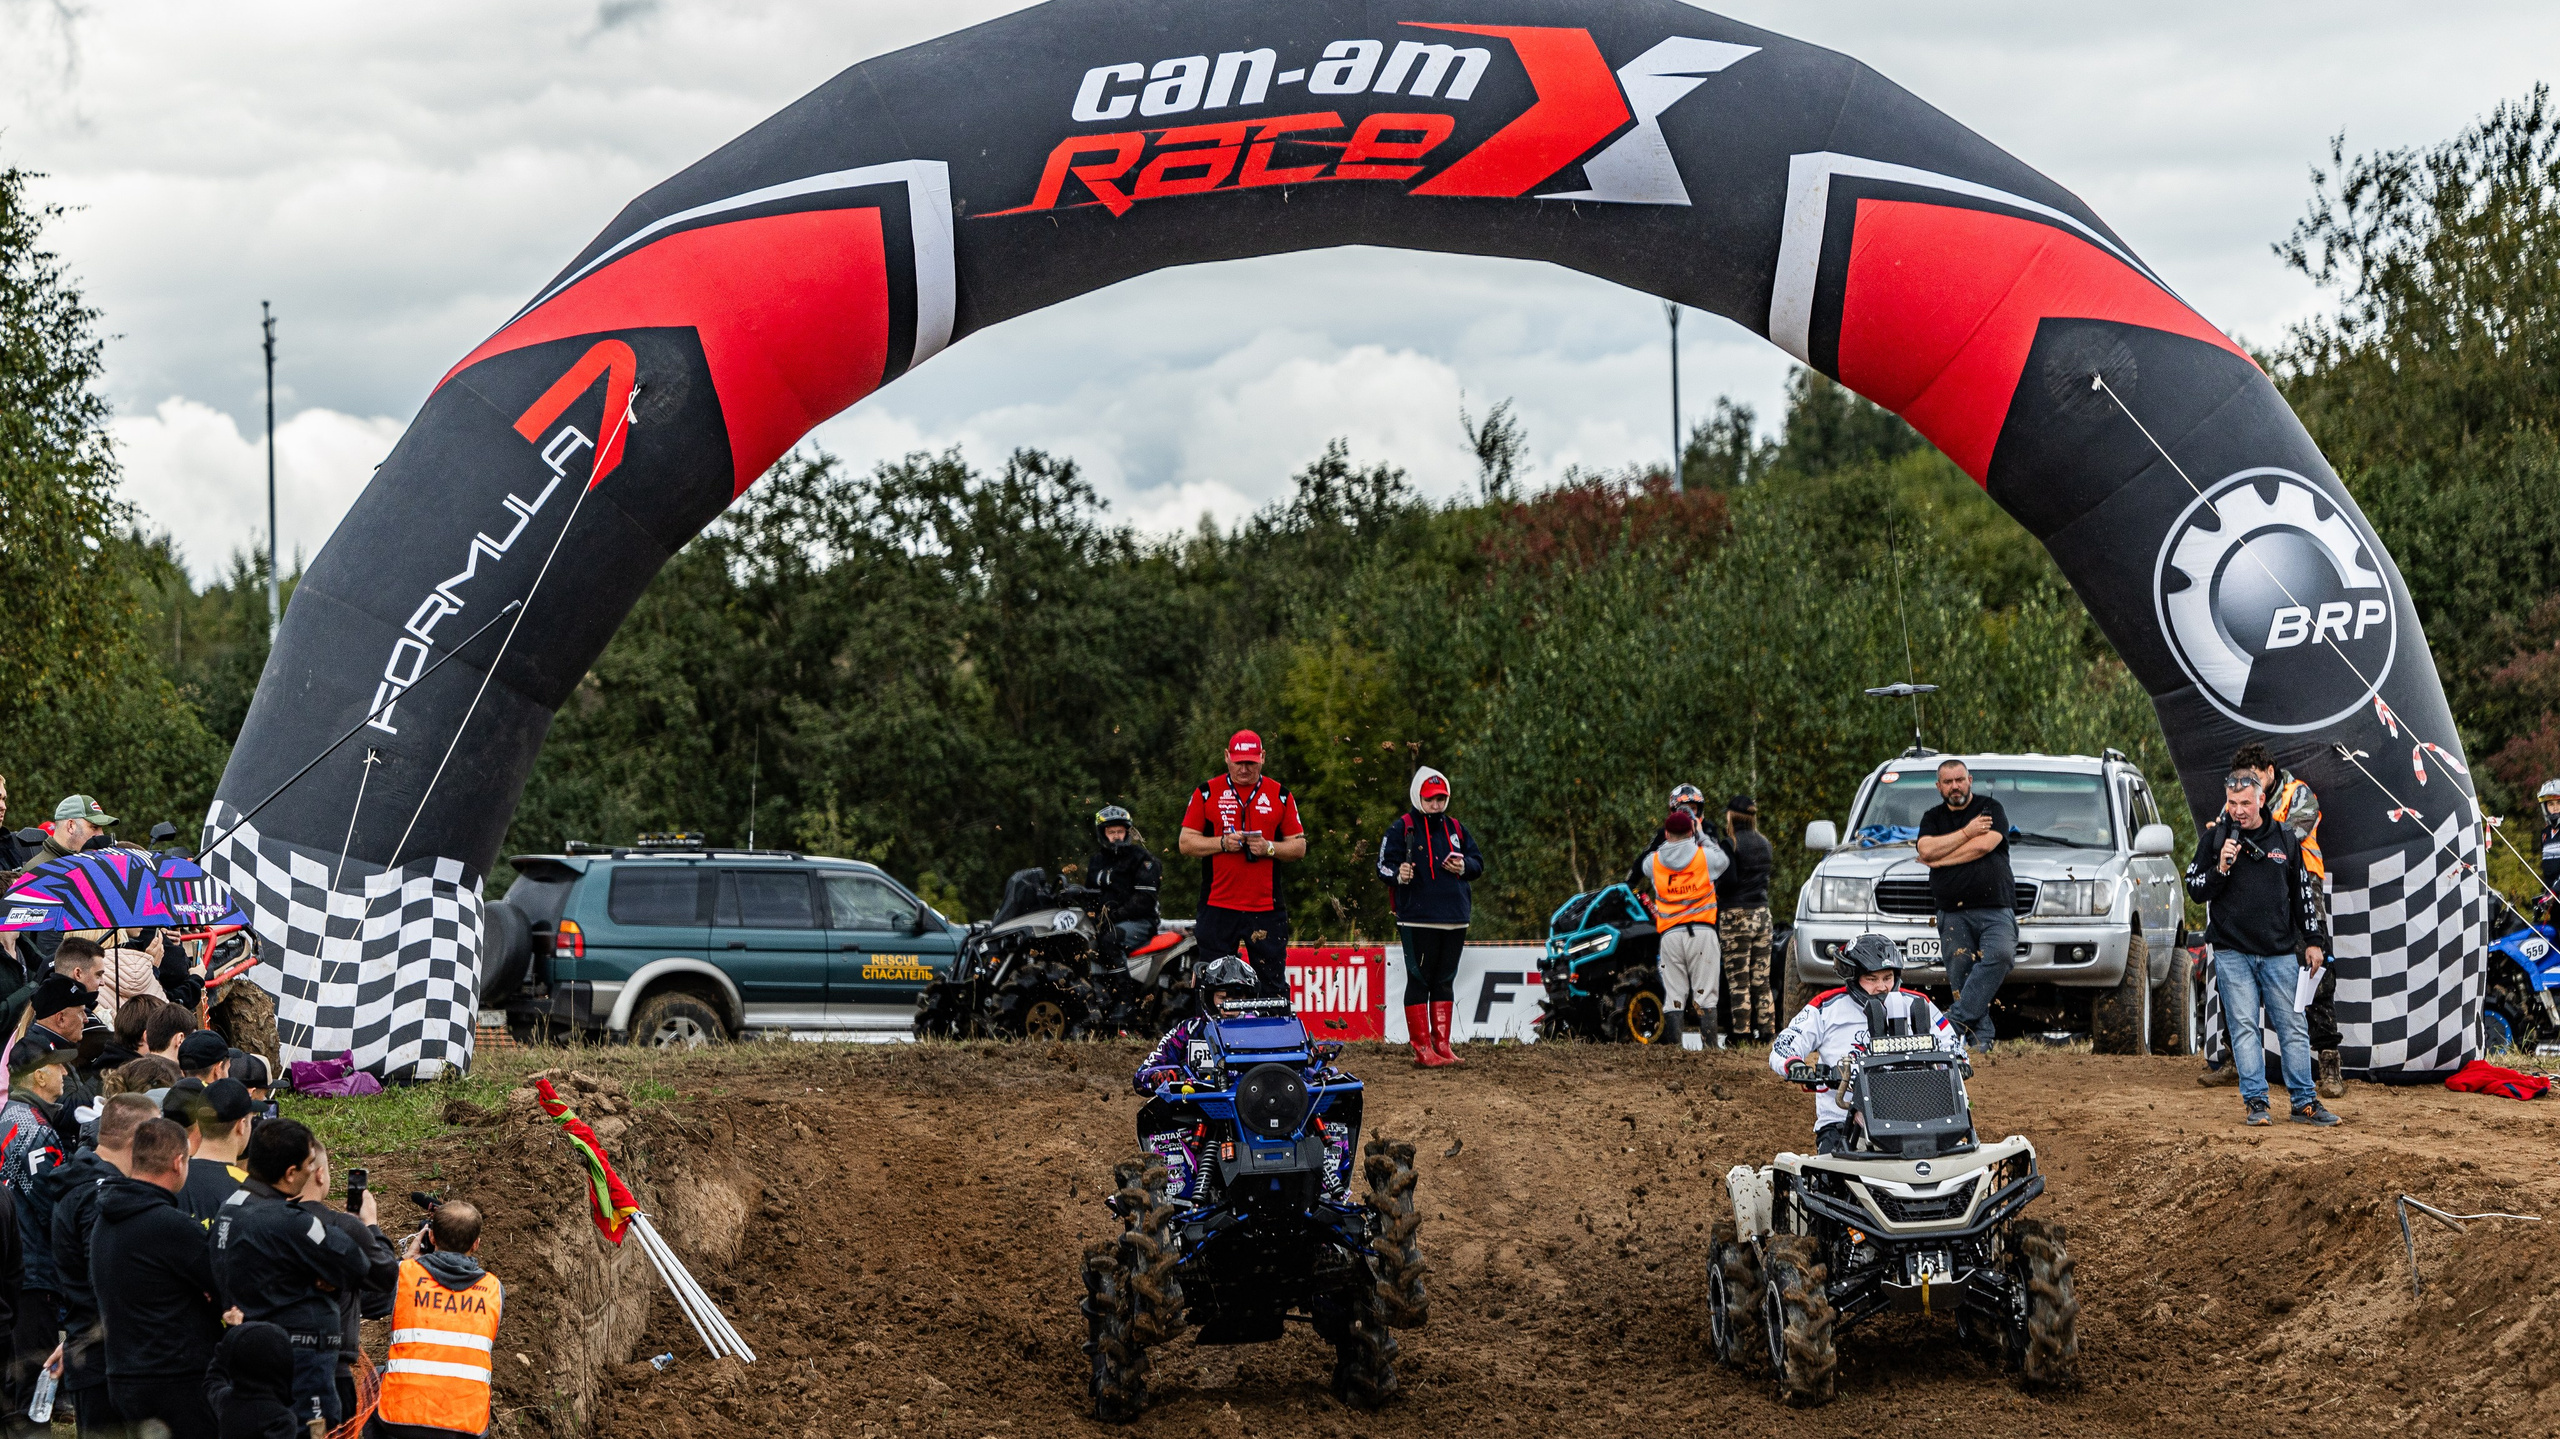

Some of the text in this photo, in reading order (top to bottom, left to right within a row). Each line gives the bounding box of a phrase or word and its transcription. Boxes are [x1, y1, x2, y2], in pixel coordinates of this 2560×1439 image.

[1071, 38, 1490, 123] can-am
[367, 424, 595, 735] FORMULA
[2265, 599, 2387, 650] BRP
[1667, 884, 1698, 895] МЕДИА
[1912, 941, 1940, 955] В09
[2526, 944, 2544, 959] 559
[871, 954, 920, 967] RESCUE
[862, 967, 934, 980] СПАСАТЕЛЬ
[1285, 956, 1368, 1013] СКИЙ
[1193, 1049, 1213, 1063] GR
[1154, 1131, 1182, 1142] ROTAX
[1158, 1142, 1183, 1150] GoPro
[414, 1290, 487, 1315] МЕДИА
[326, 1335, 342, 1346] TRA
[310, 1396, 323, 1420] FIN
